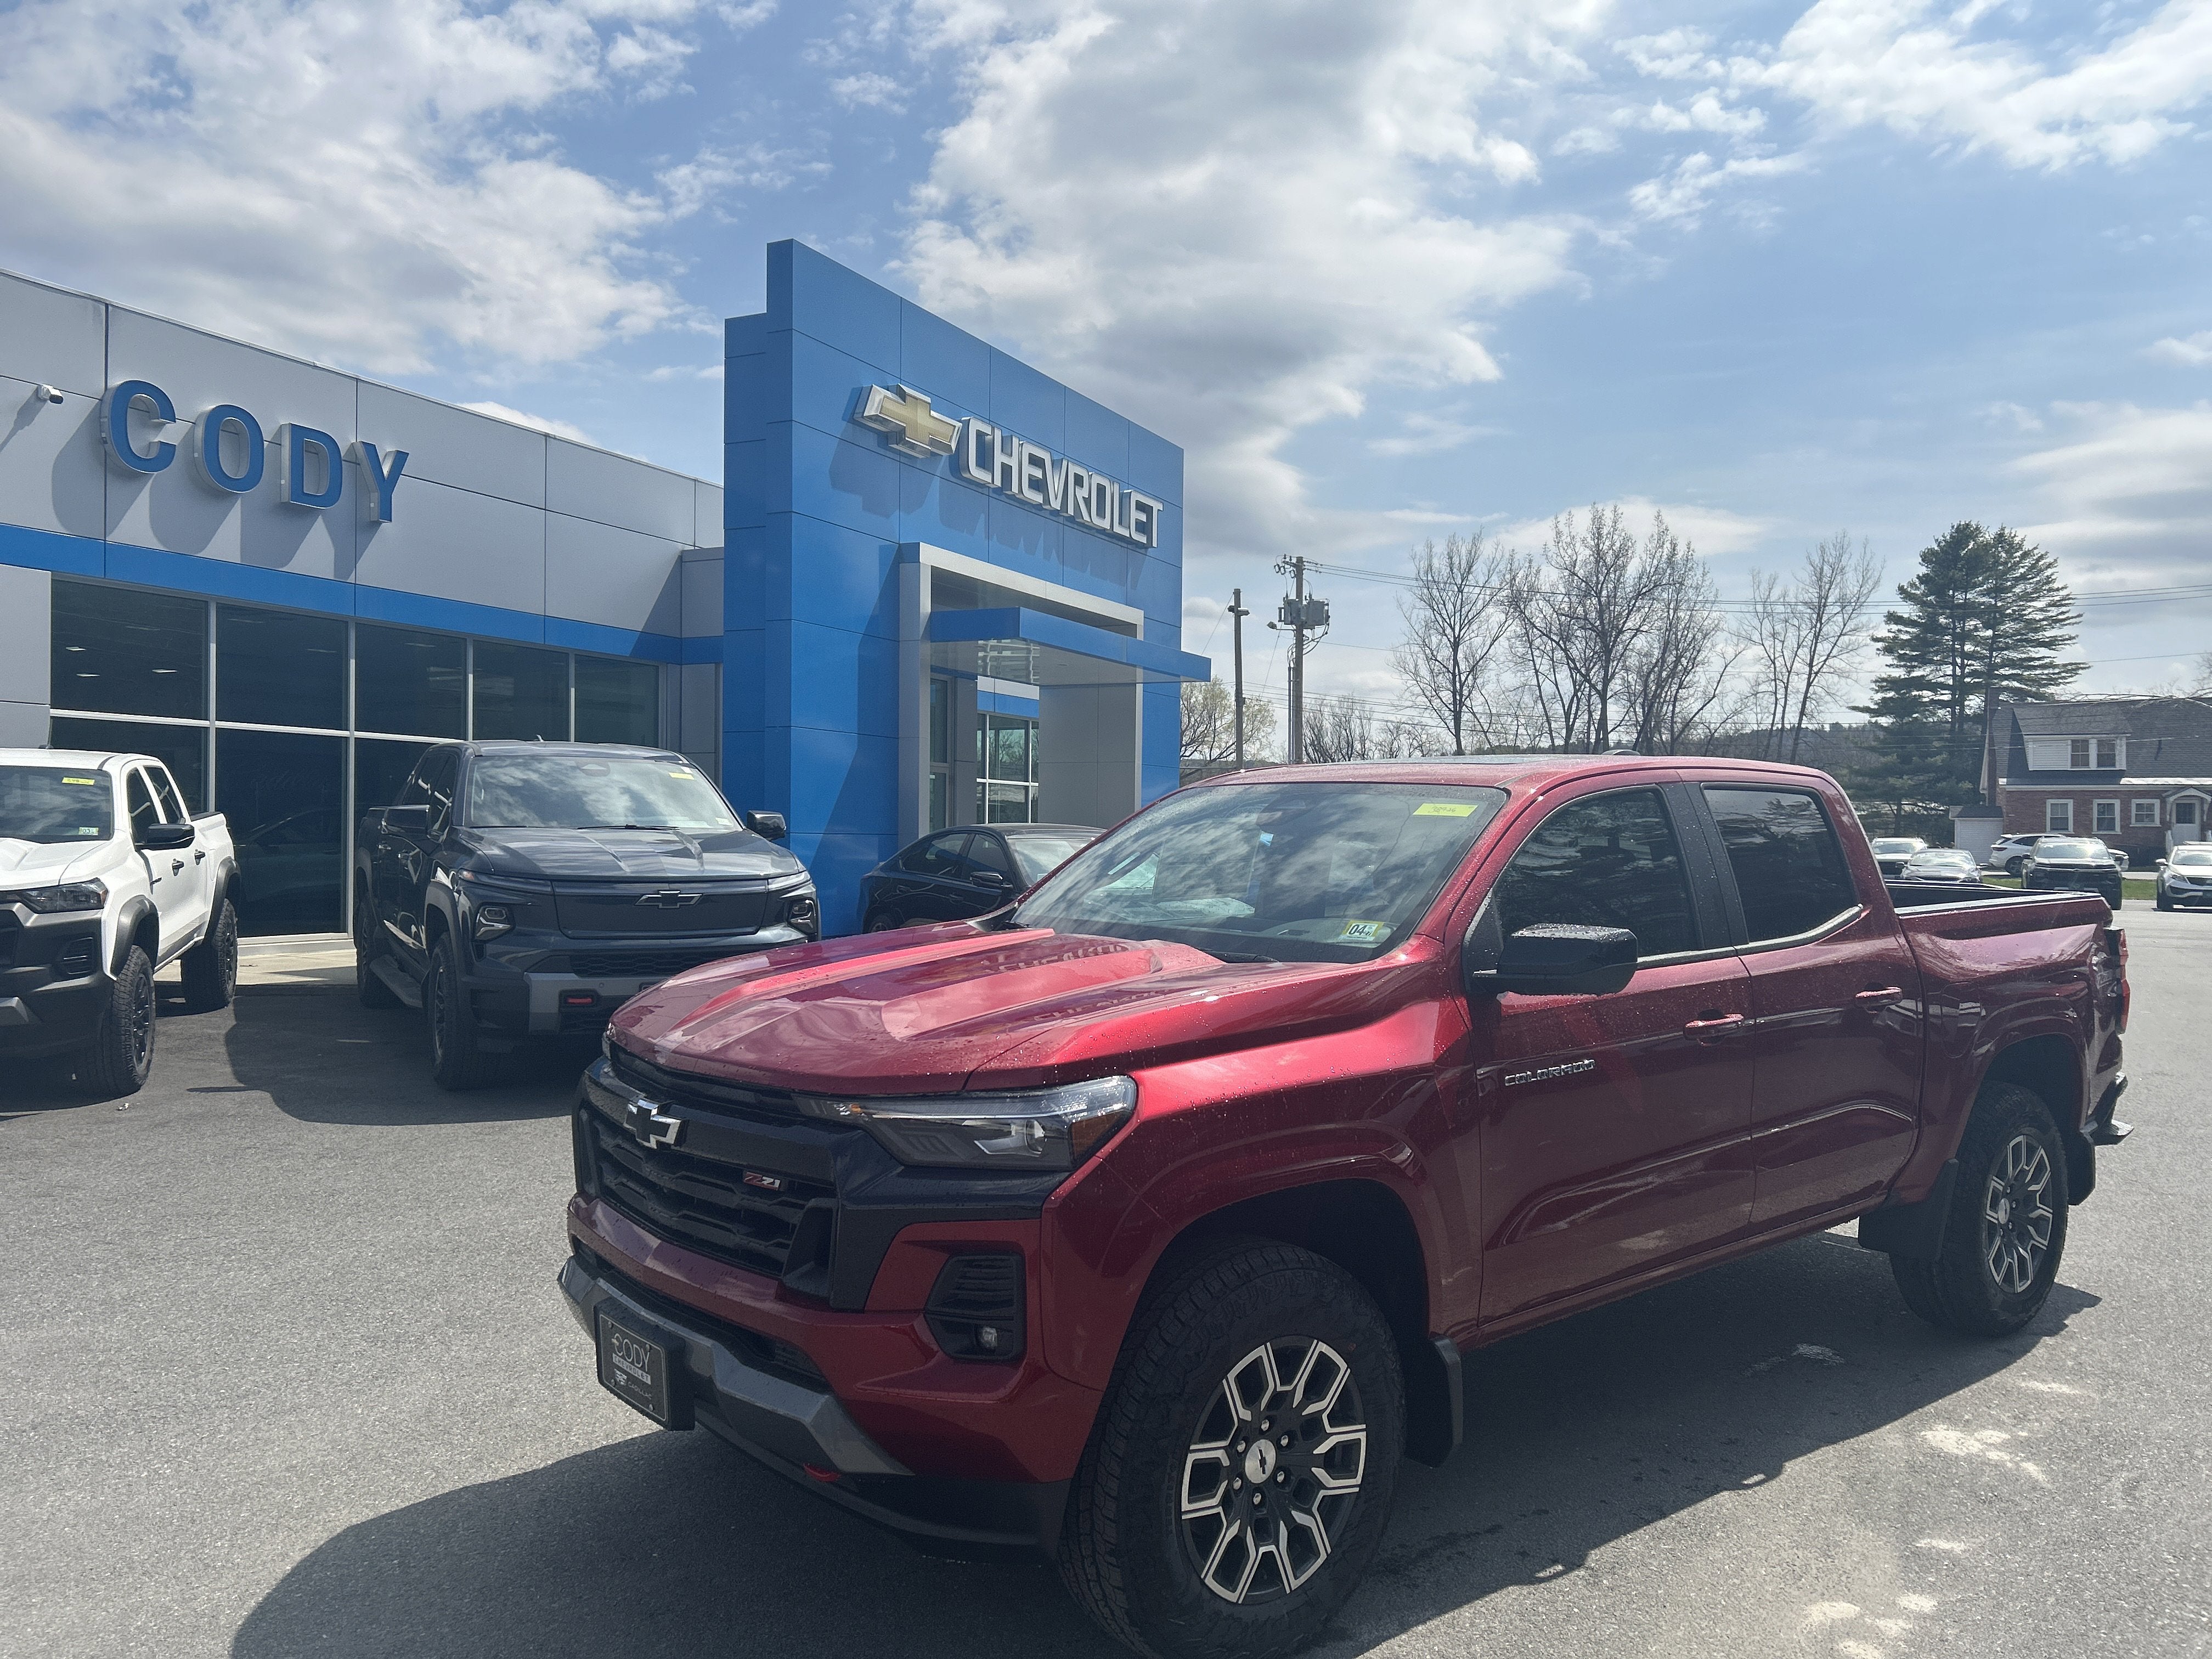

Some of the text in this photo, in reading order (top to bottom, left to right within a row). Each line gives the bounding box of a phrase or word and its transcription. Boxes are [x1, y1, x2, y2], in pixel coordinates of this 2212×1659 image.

[102, 379, 410, 523] CODY
[960, 416, 1164, 548] CHEVROLET
[1348, 924, 1368, 935] 04
[1505, 1059, 1595, 1086] COLORADO
[744, 1171, 781, 1191] Z71
[613, 1333, 650, 1372] CODY
[613, 1355, 651, 1384] CHEVROLET
